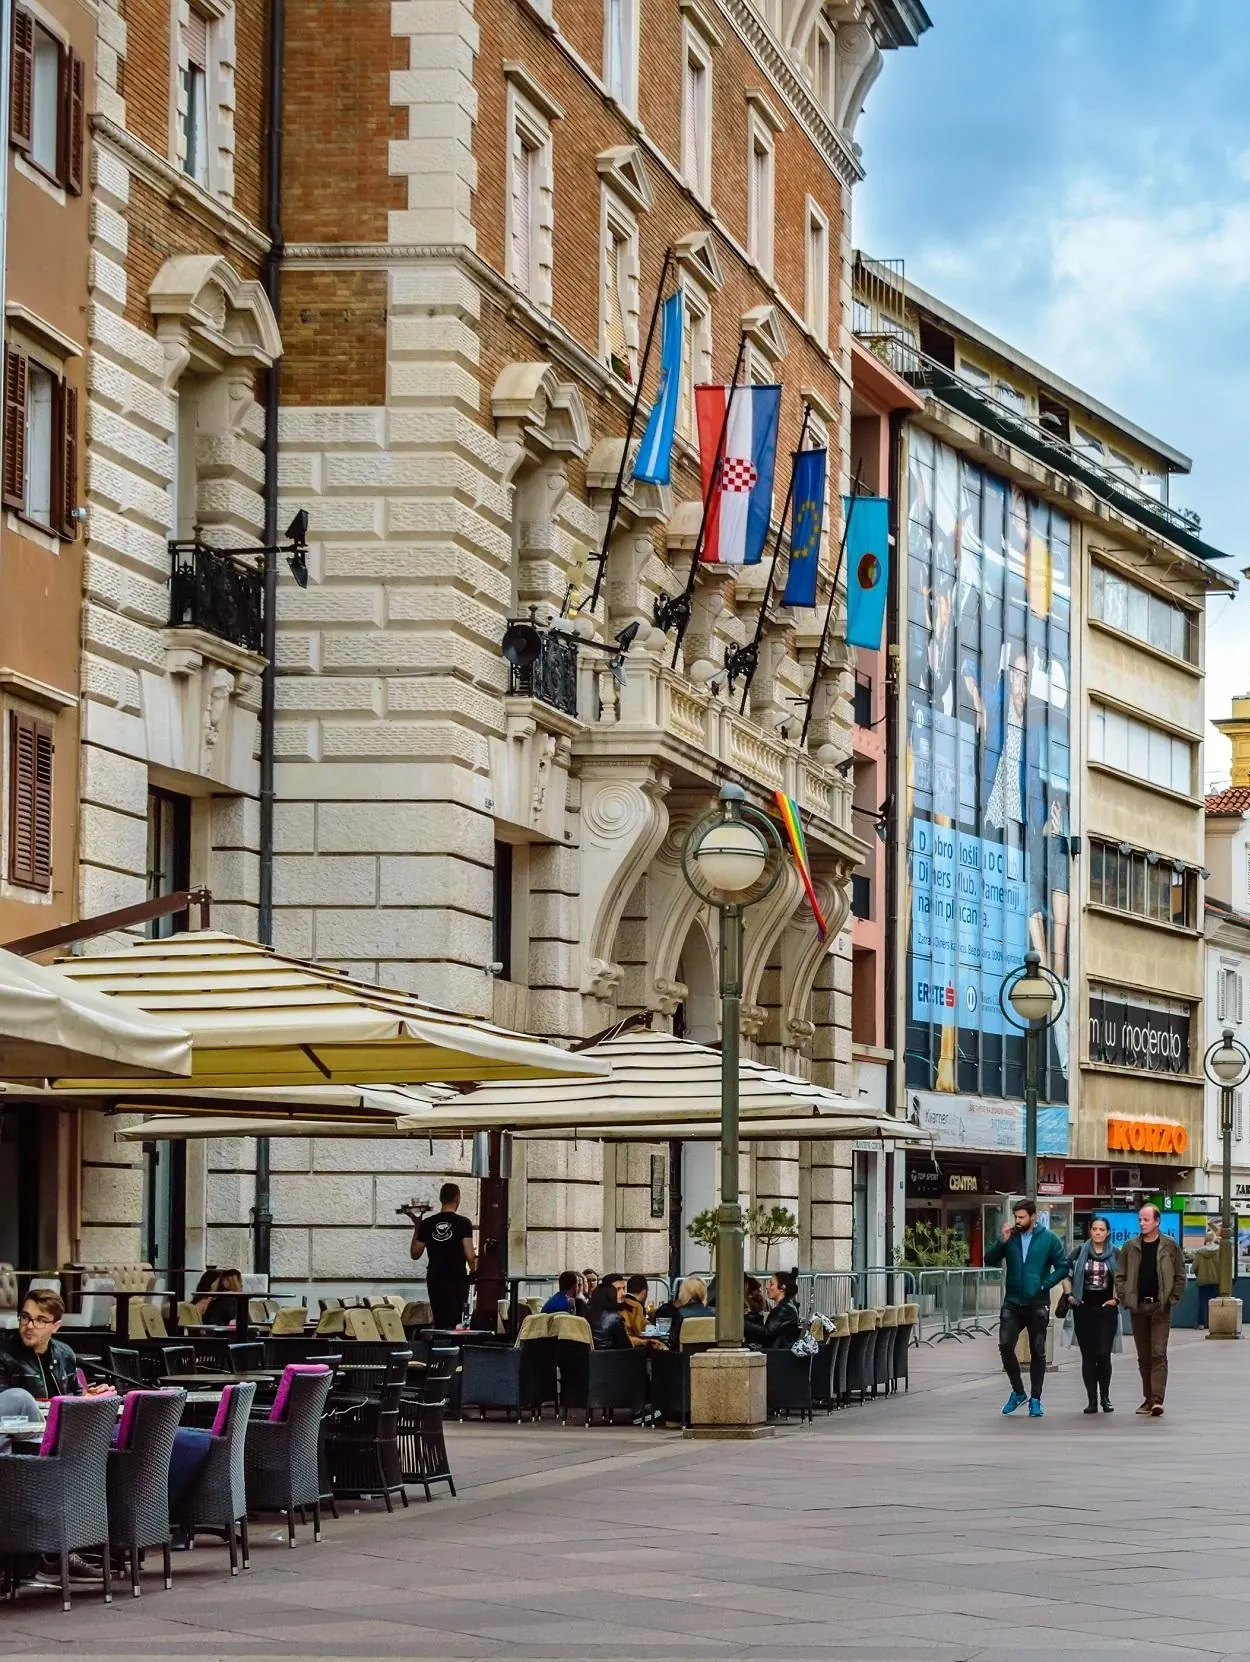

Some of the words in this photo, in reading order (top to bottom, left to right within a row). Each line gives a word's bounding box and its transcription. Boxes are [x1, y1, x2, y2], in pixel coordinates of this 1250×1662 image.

[960, 842, 978, 867] ošli
[958, 872, 977, 896] lub.
[918, 895, 943, 917] nain
[918, 982, 944, 1006] ERTE
[1121, 1021, 1182, 1058] moderato
[1108, 1118, 1189, 1154] KORZO
[949, 1174, 978, 1191] CENTRA
